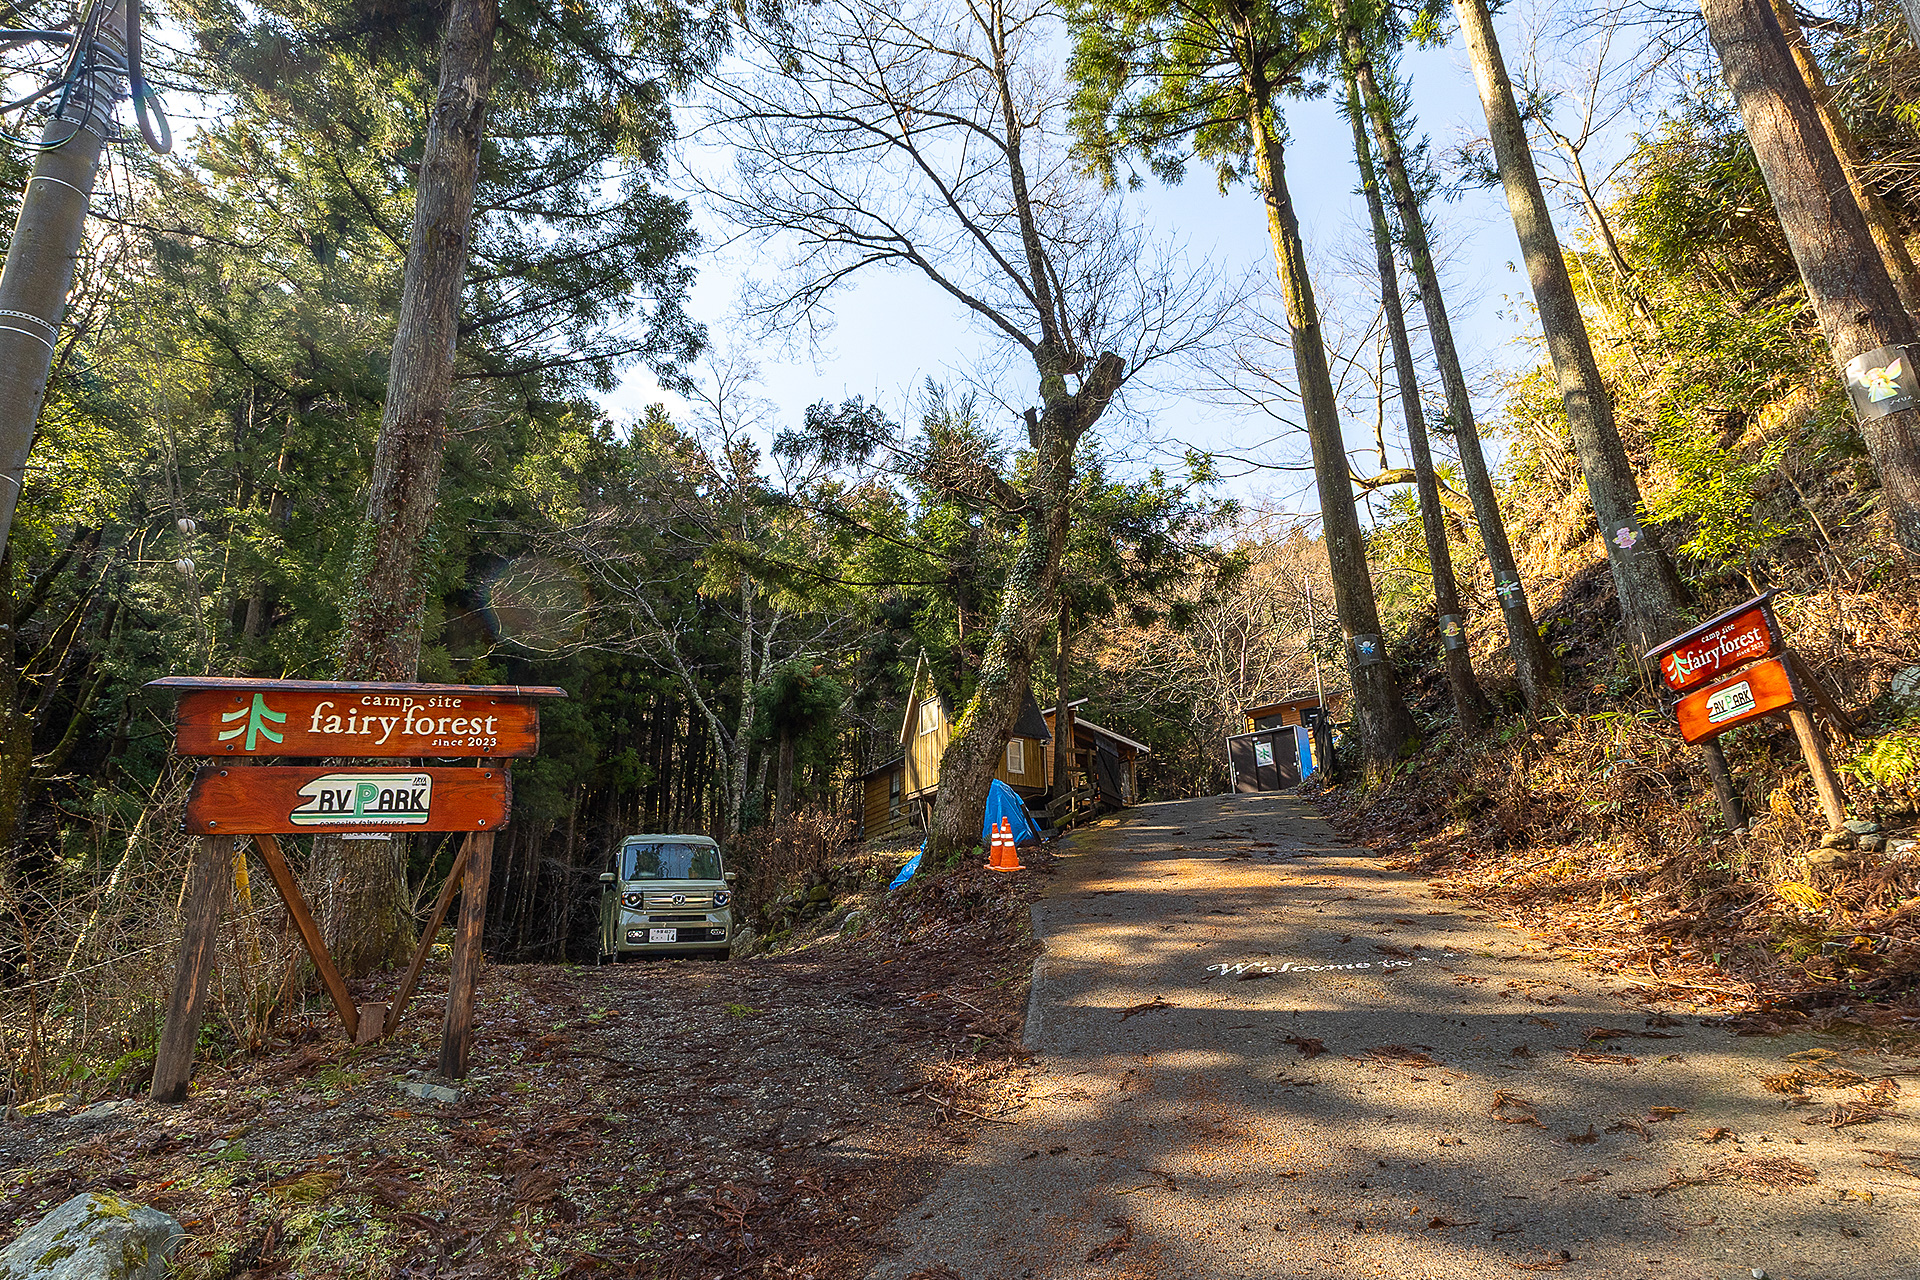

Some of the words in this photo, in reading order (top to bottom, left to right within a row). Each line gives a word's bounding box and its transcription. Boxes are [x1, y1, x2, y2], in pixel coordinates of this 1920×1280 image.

[1701, 630, 1720, 643] camp
[1722, 623, 1736, 634] site
[1686, 627, 1762, 671] fairyforest
[1736, 647, 1750, 657] since
[1750, 640, 1765, 651] 2023
[361, 695, 414, 712] camp
[428, 695, 462, 708] site
[1713, 699, 1724, 714] RV
[1724, 689, 1751, 712] PARK
[307, 701, 498, 745] fairyforest
[431, 738, 463, 747] since
[467, 736, 497, 747] 2023
[318, 789, 352, 811] RV
[354, 782, 427, 815] PARK
[1206, 960, 1371, 976] Welcome
[1378, 959, 1412, 968] to
